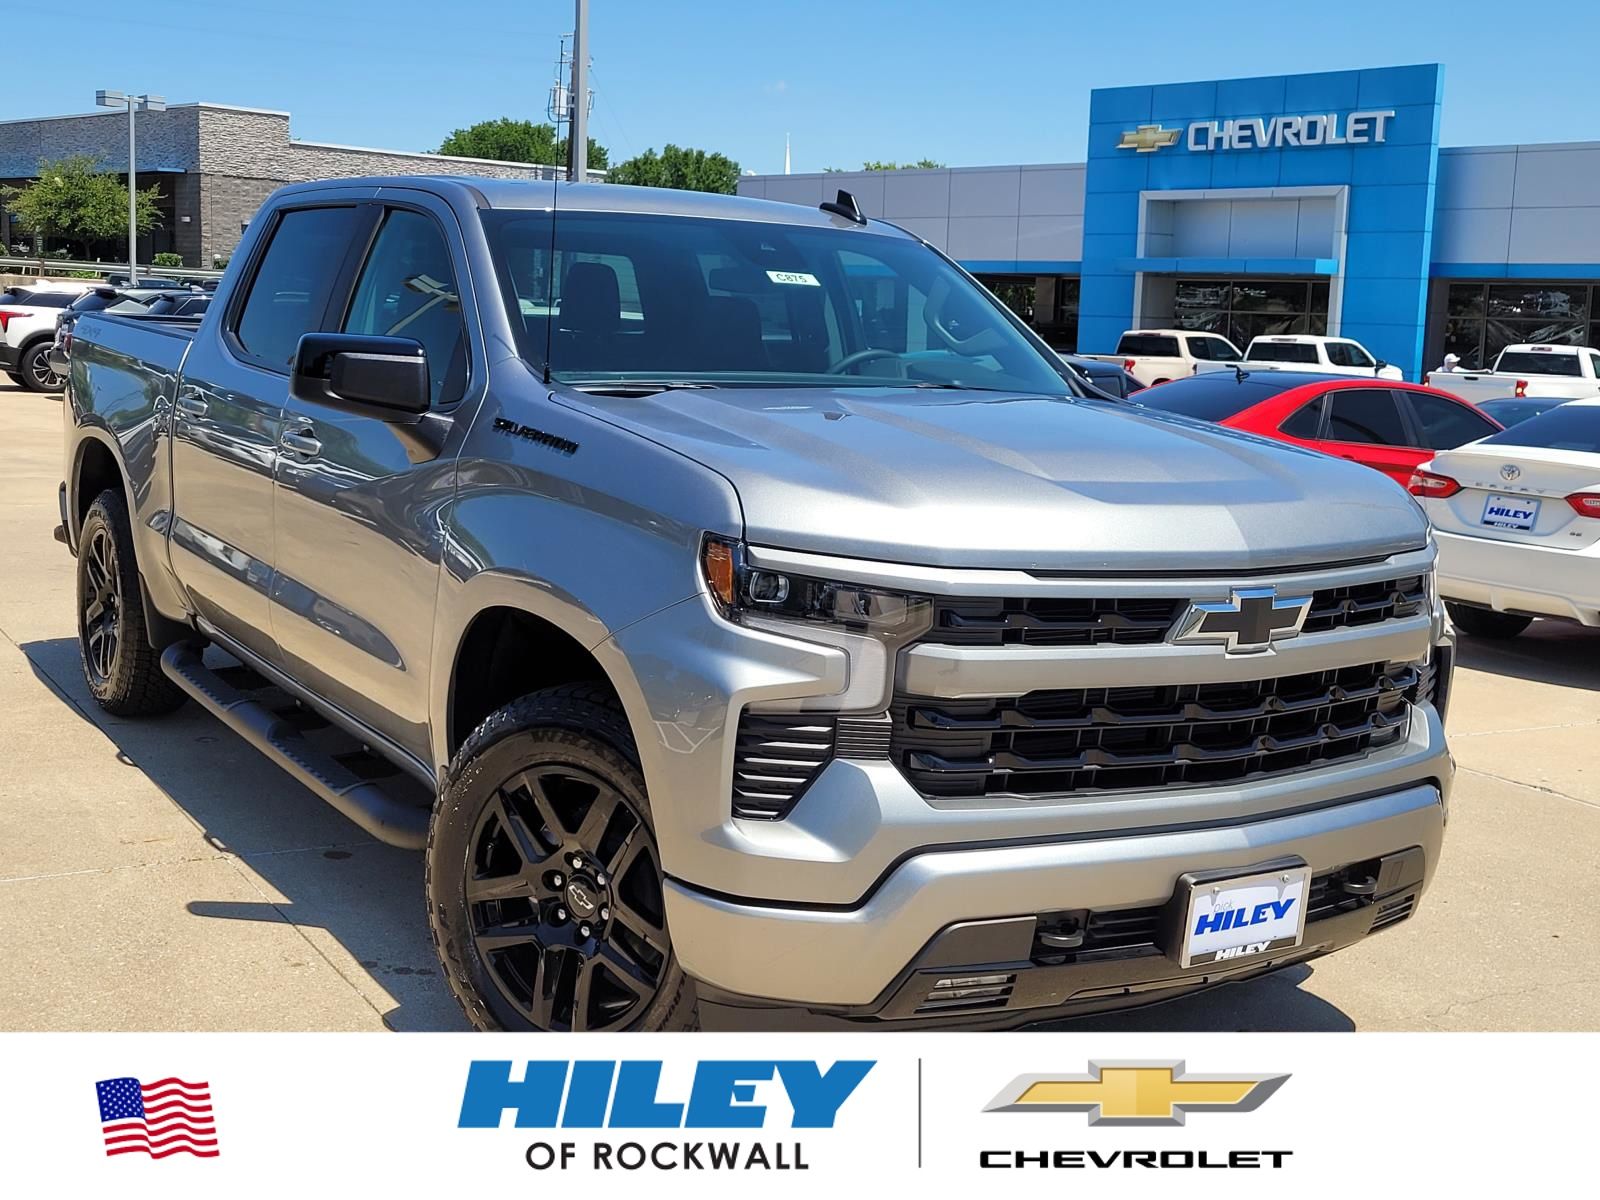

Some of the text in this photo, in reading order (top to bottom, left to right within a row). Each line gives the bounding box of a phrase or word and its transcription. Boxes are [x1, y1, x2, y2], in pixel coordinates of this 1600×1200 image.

[1187, 110, 1395, 151] CHEVROLET
[1488, 507, 1533, 519] HILEY
[1194, 898, 1296, 936] HILEY
[1215, 941, 1271, 960] HILEY
